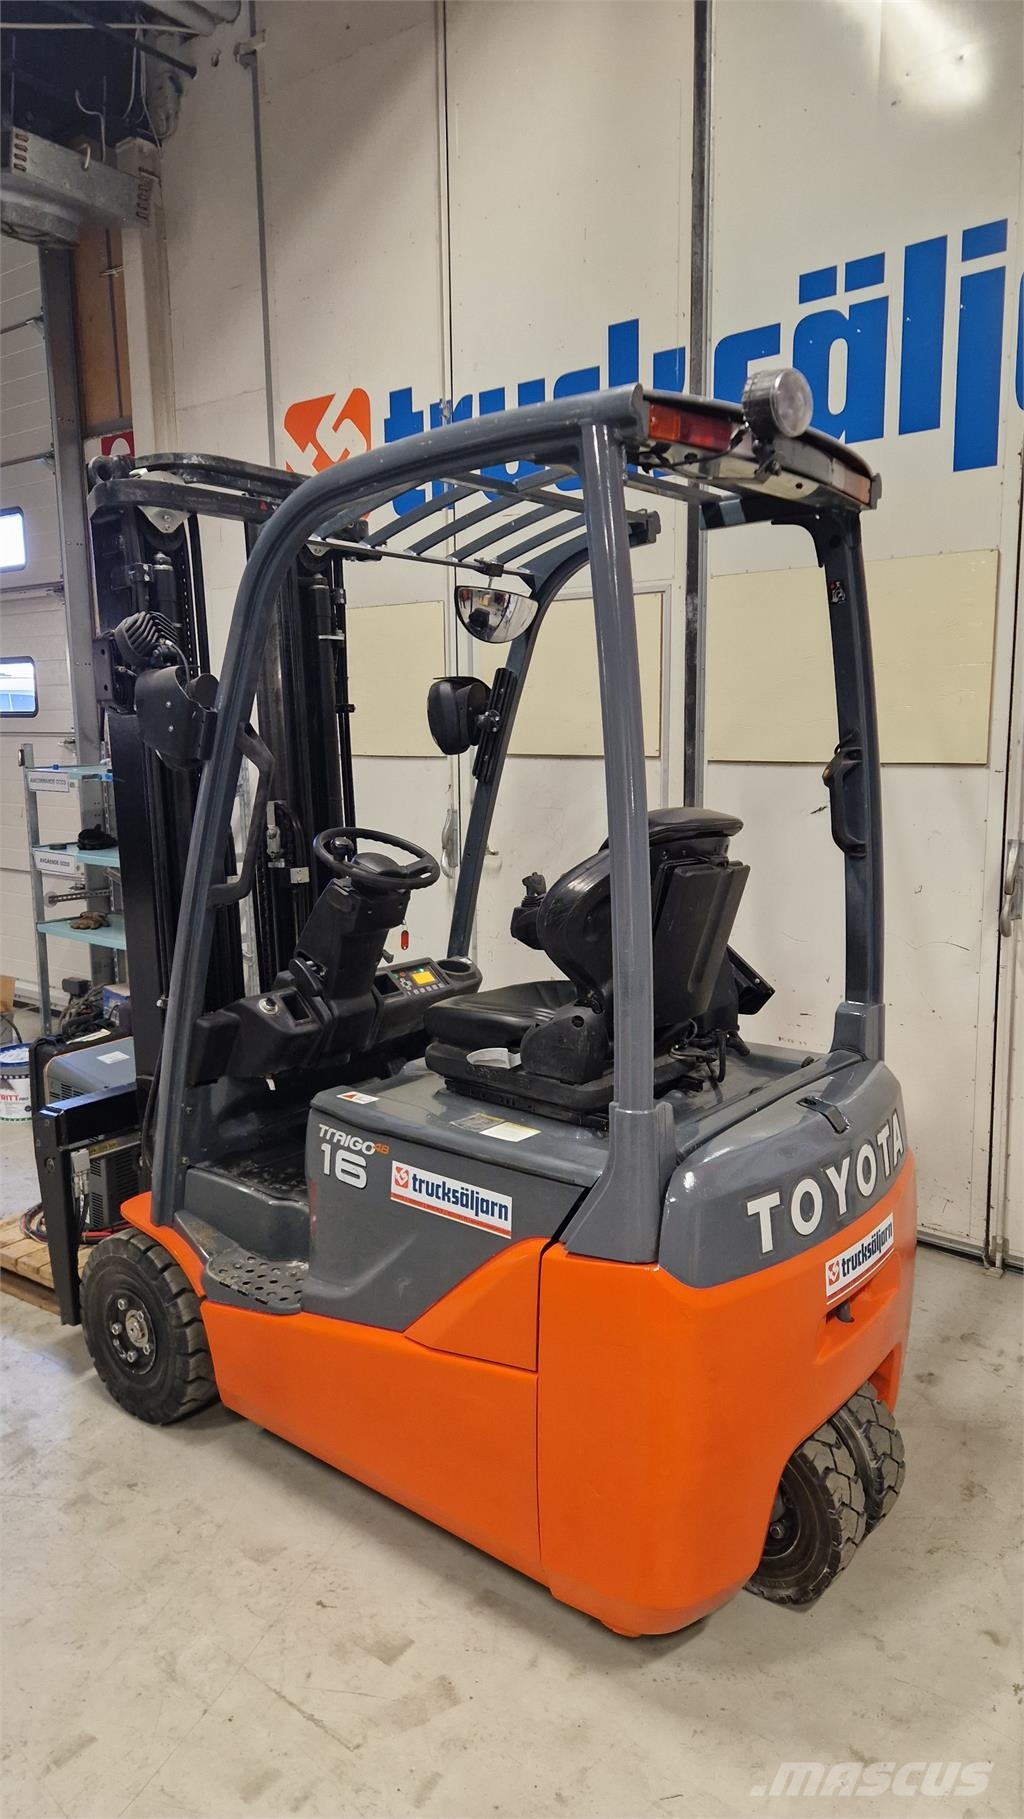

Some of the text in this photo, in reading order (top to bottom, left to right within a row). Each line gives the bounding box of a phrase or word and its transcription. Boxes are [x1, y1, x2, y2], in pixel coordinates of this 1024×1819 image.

[384, 218, 1024, 519] trucksälj
[320, 1142, 367, 1189] 16
[747, 1112, 905, 1255] TOYOTA
[412, 1173, 509, 1222] trucksäljarn
[841, 1221, 893, 1278] trucksäljarn
